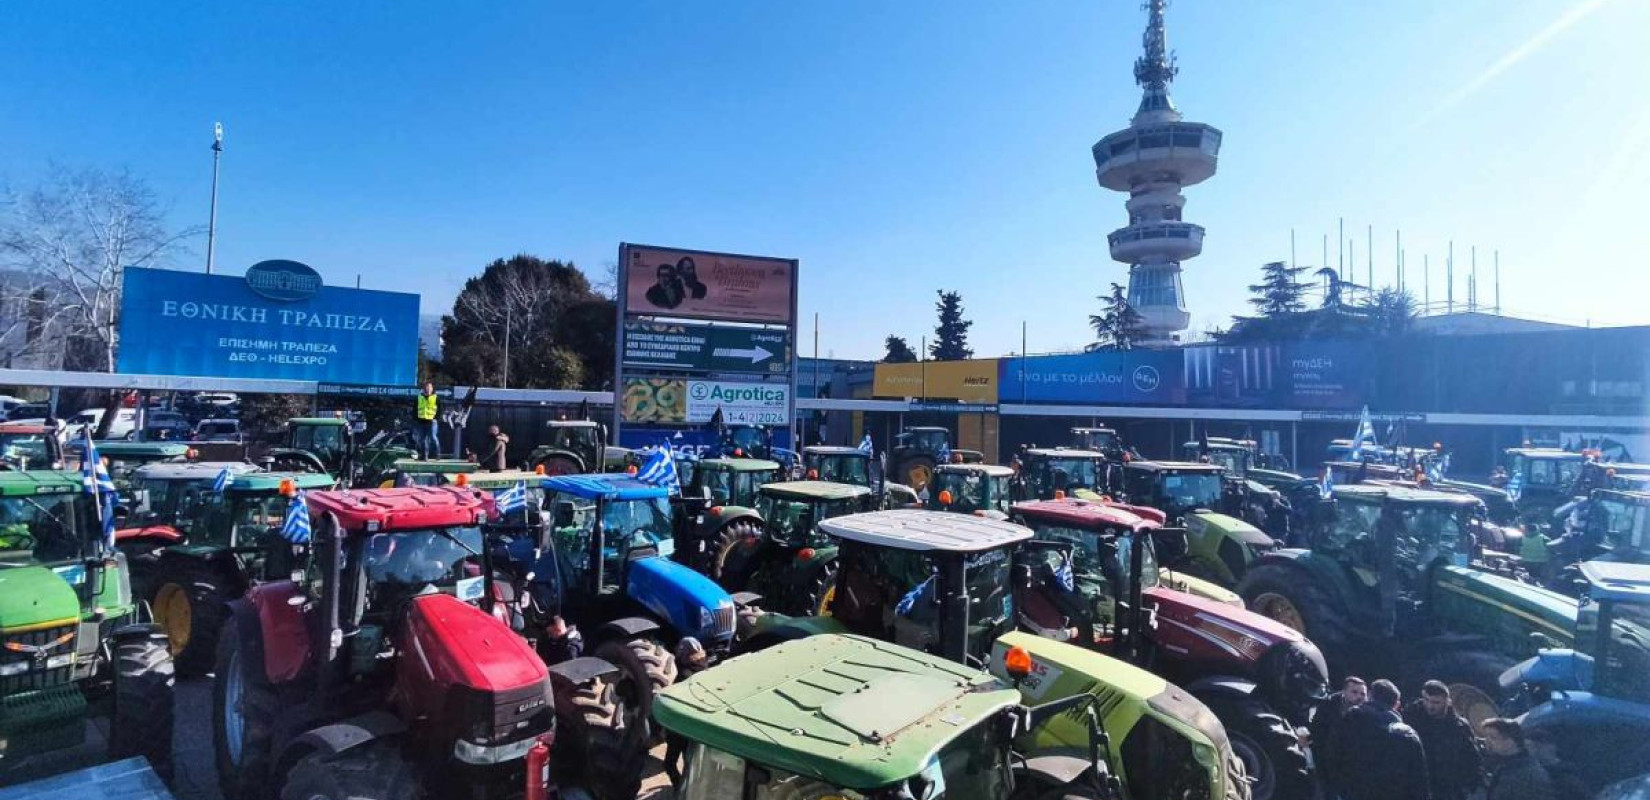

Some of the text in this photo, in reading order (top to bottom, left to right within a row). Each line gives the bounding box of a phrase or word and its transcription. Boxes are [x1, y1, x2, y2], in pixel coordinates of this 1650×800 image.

[161, 300, 388, 332] ΕΘΝΙΚΗ ΤΡΑΠΕΖΑ
[219, 337, 338, 353] ΕΠΙΣΗΜΗ ΤΡΑΠΕΖΑ
[229, 352, 257, 362] ΔΕΘ
[268, 354, 327, 365] HELEXPO
[964, 376, 989, 385] Hertz
[710, 385, 785, 403] Agrotica
